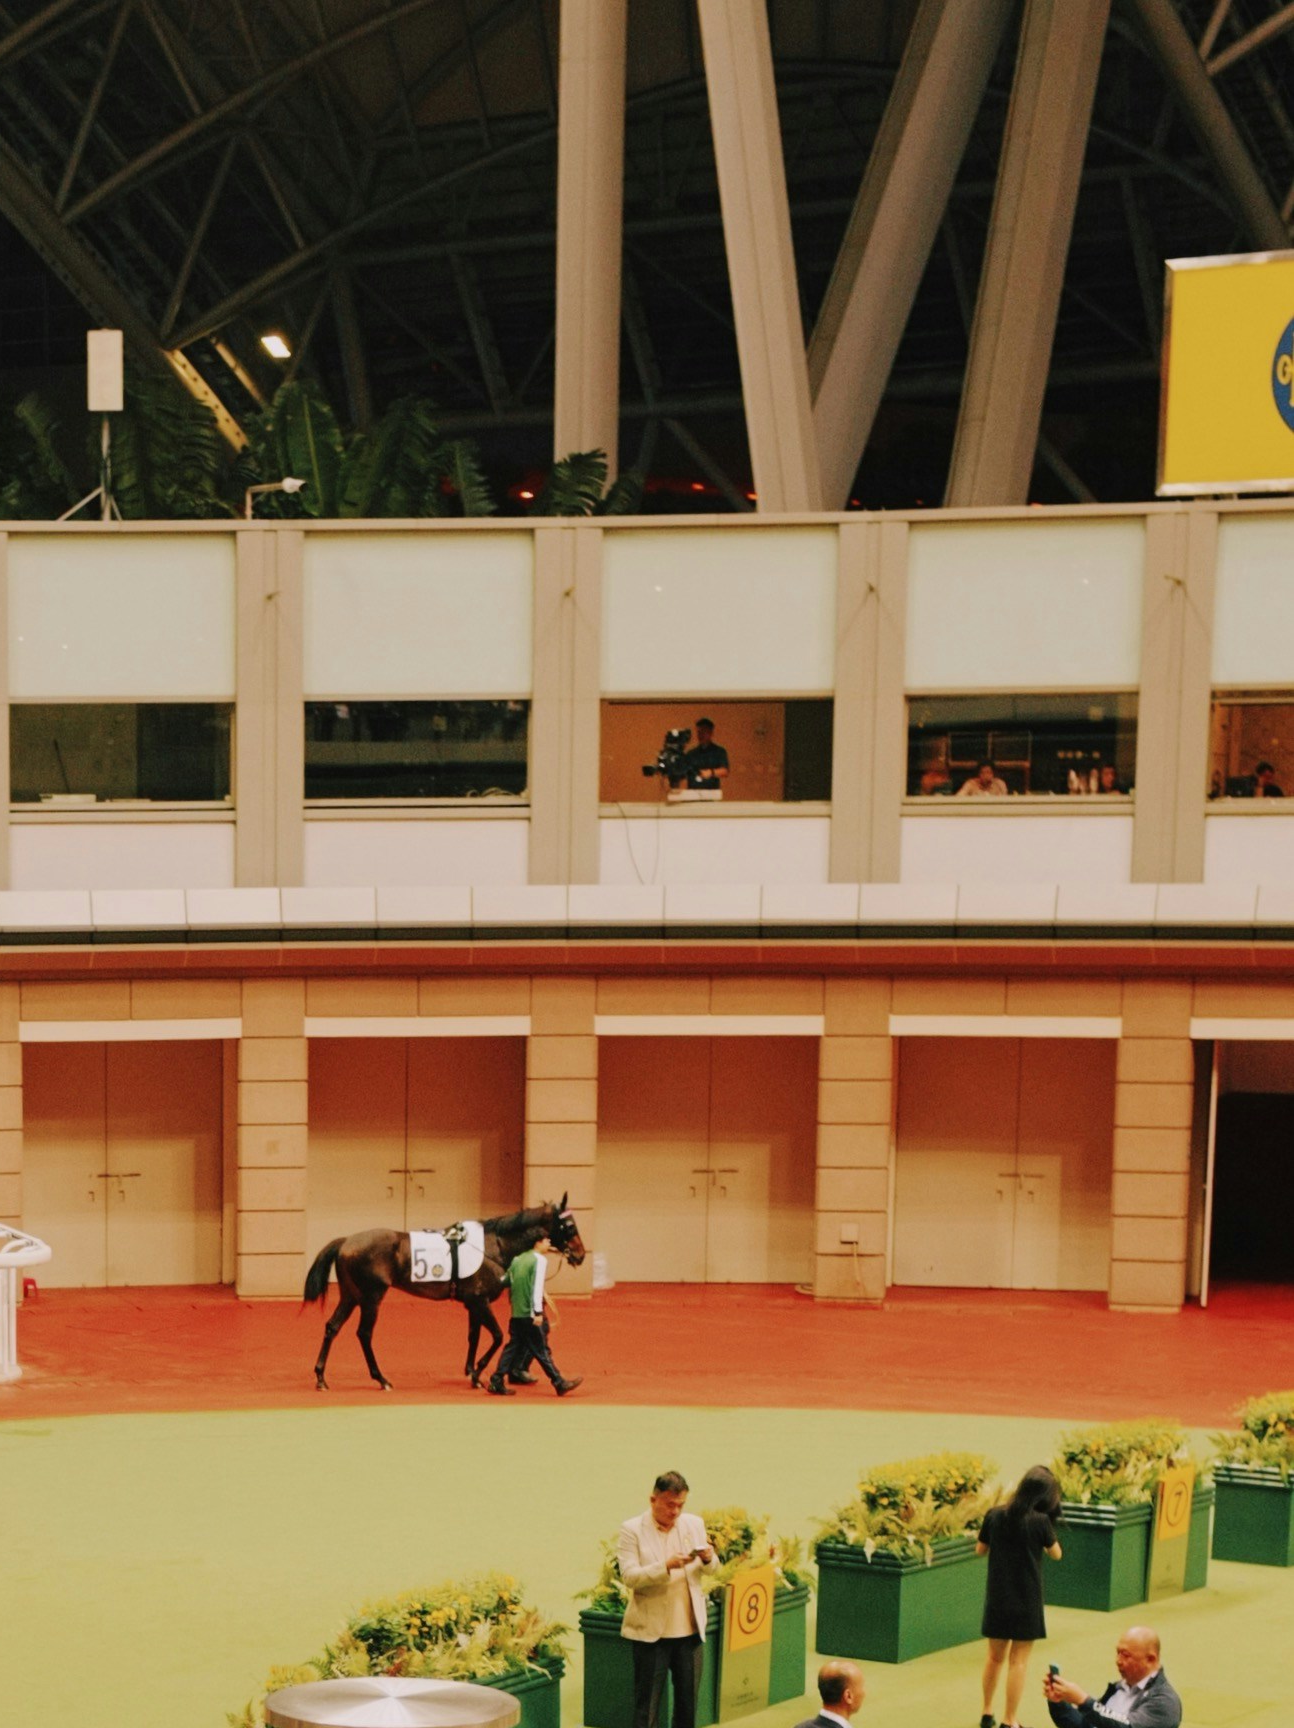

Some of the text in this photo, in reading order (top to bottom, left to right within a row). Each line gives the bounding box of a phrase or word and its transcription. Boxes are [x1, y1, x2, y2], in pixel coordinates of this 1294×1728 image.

[413, 1248, 428, 1280] 5
[1174, 1490, 1183, 1516] 7
[746, 1593, 759, 1624] 8
